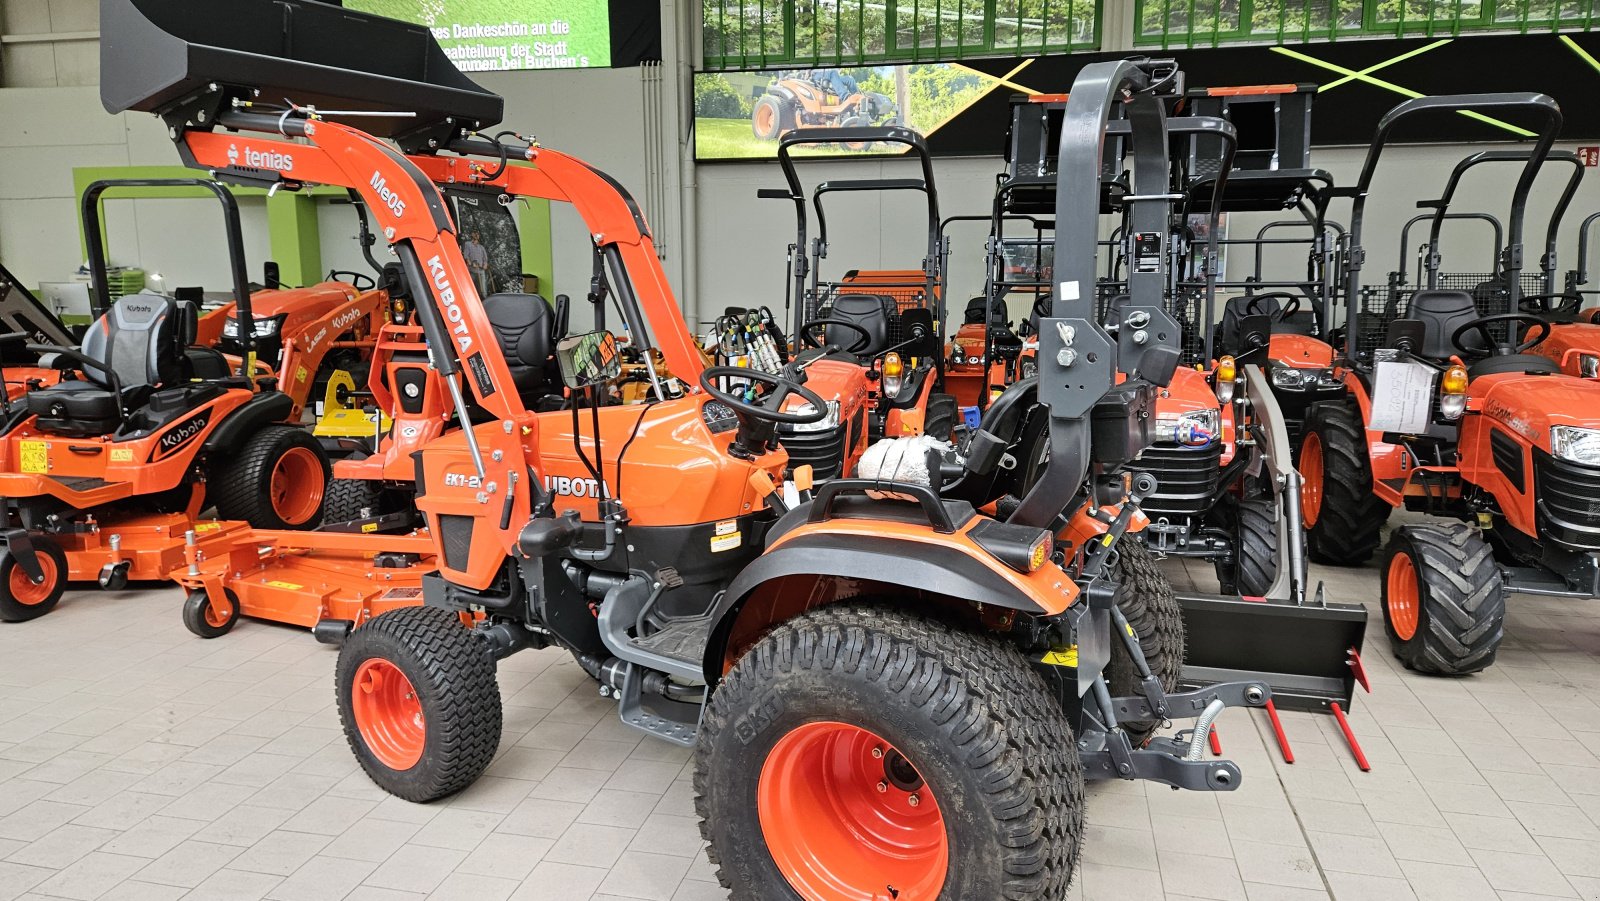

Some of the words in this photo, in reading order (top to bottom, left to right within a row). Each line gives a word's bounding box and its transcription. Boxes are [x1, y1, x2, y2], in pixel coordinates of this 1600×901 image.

[453, 22, 527, 38] Dankeschön
[531, 24, 546, 35] an
[550, 20, 569, 34] die
[511, 43, 530, 57] der
[534, 41, 567, 56] Stadt
[502, 57, 521, 69] bei
[244, 146, 293, 171] tenias
[369, 170, 406, 218] Me05
[127, 304, 151, 313] Kubota
[427, 255, 473, 354] KUBOTA
[332, 308, 361, 328] Kubota
[162, 418, 205, 446] Kubota
[445, 473, 482, 488] EK1-2
[737, 691, 782, 742] BKT
